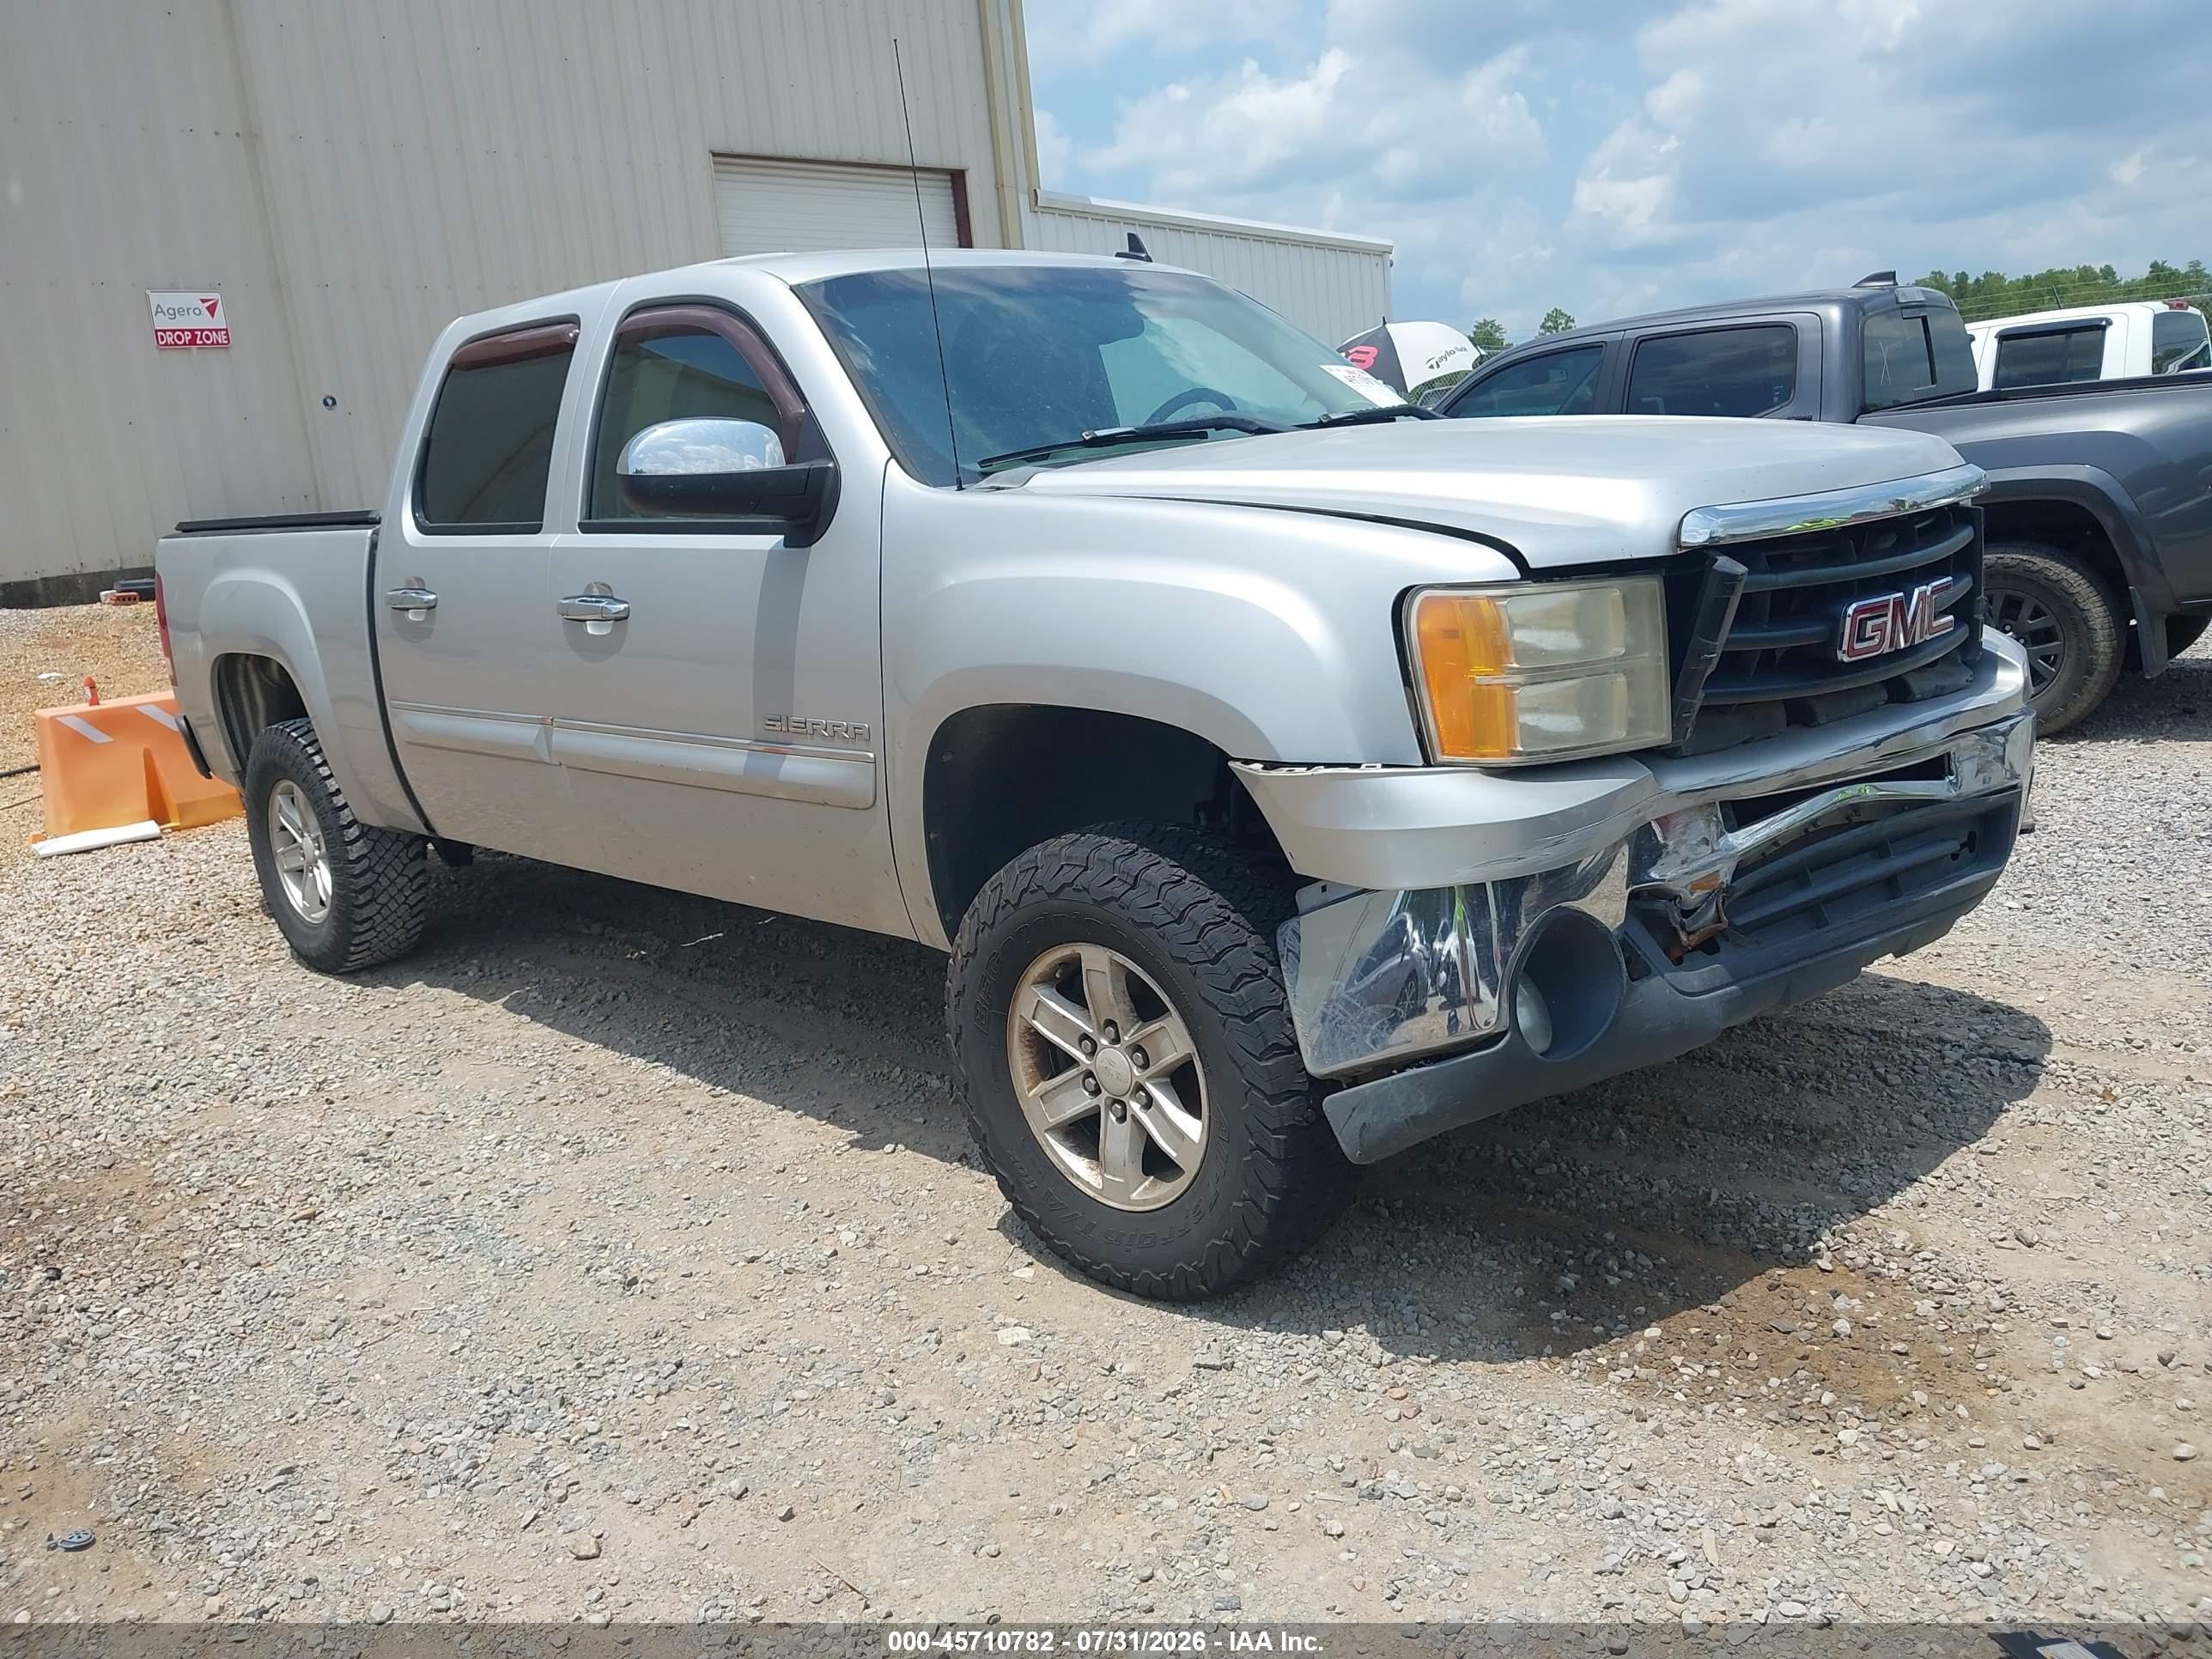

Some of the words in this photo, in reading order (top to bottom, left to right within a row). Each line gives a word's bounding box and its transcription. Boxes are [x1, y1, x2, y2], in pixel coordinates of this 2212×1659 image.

[155, 303, 202, 320] Agero
[157, 331, 192, 345] DROP
[195, 331, 228, 344] ZONE
[1839, 576, 1954, 662] GMC
[763, 714, 871, 741] SIERRA
